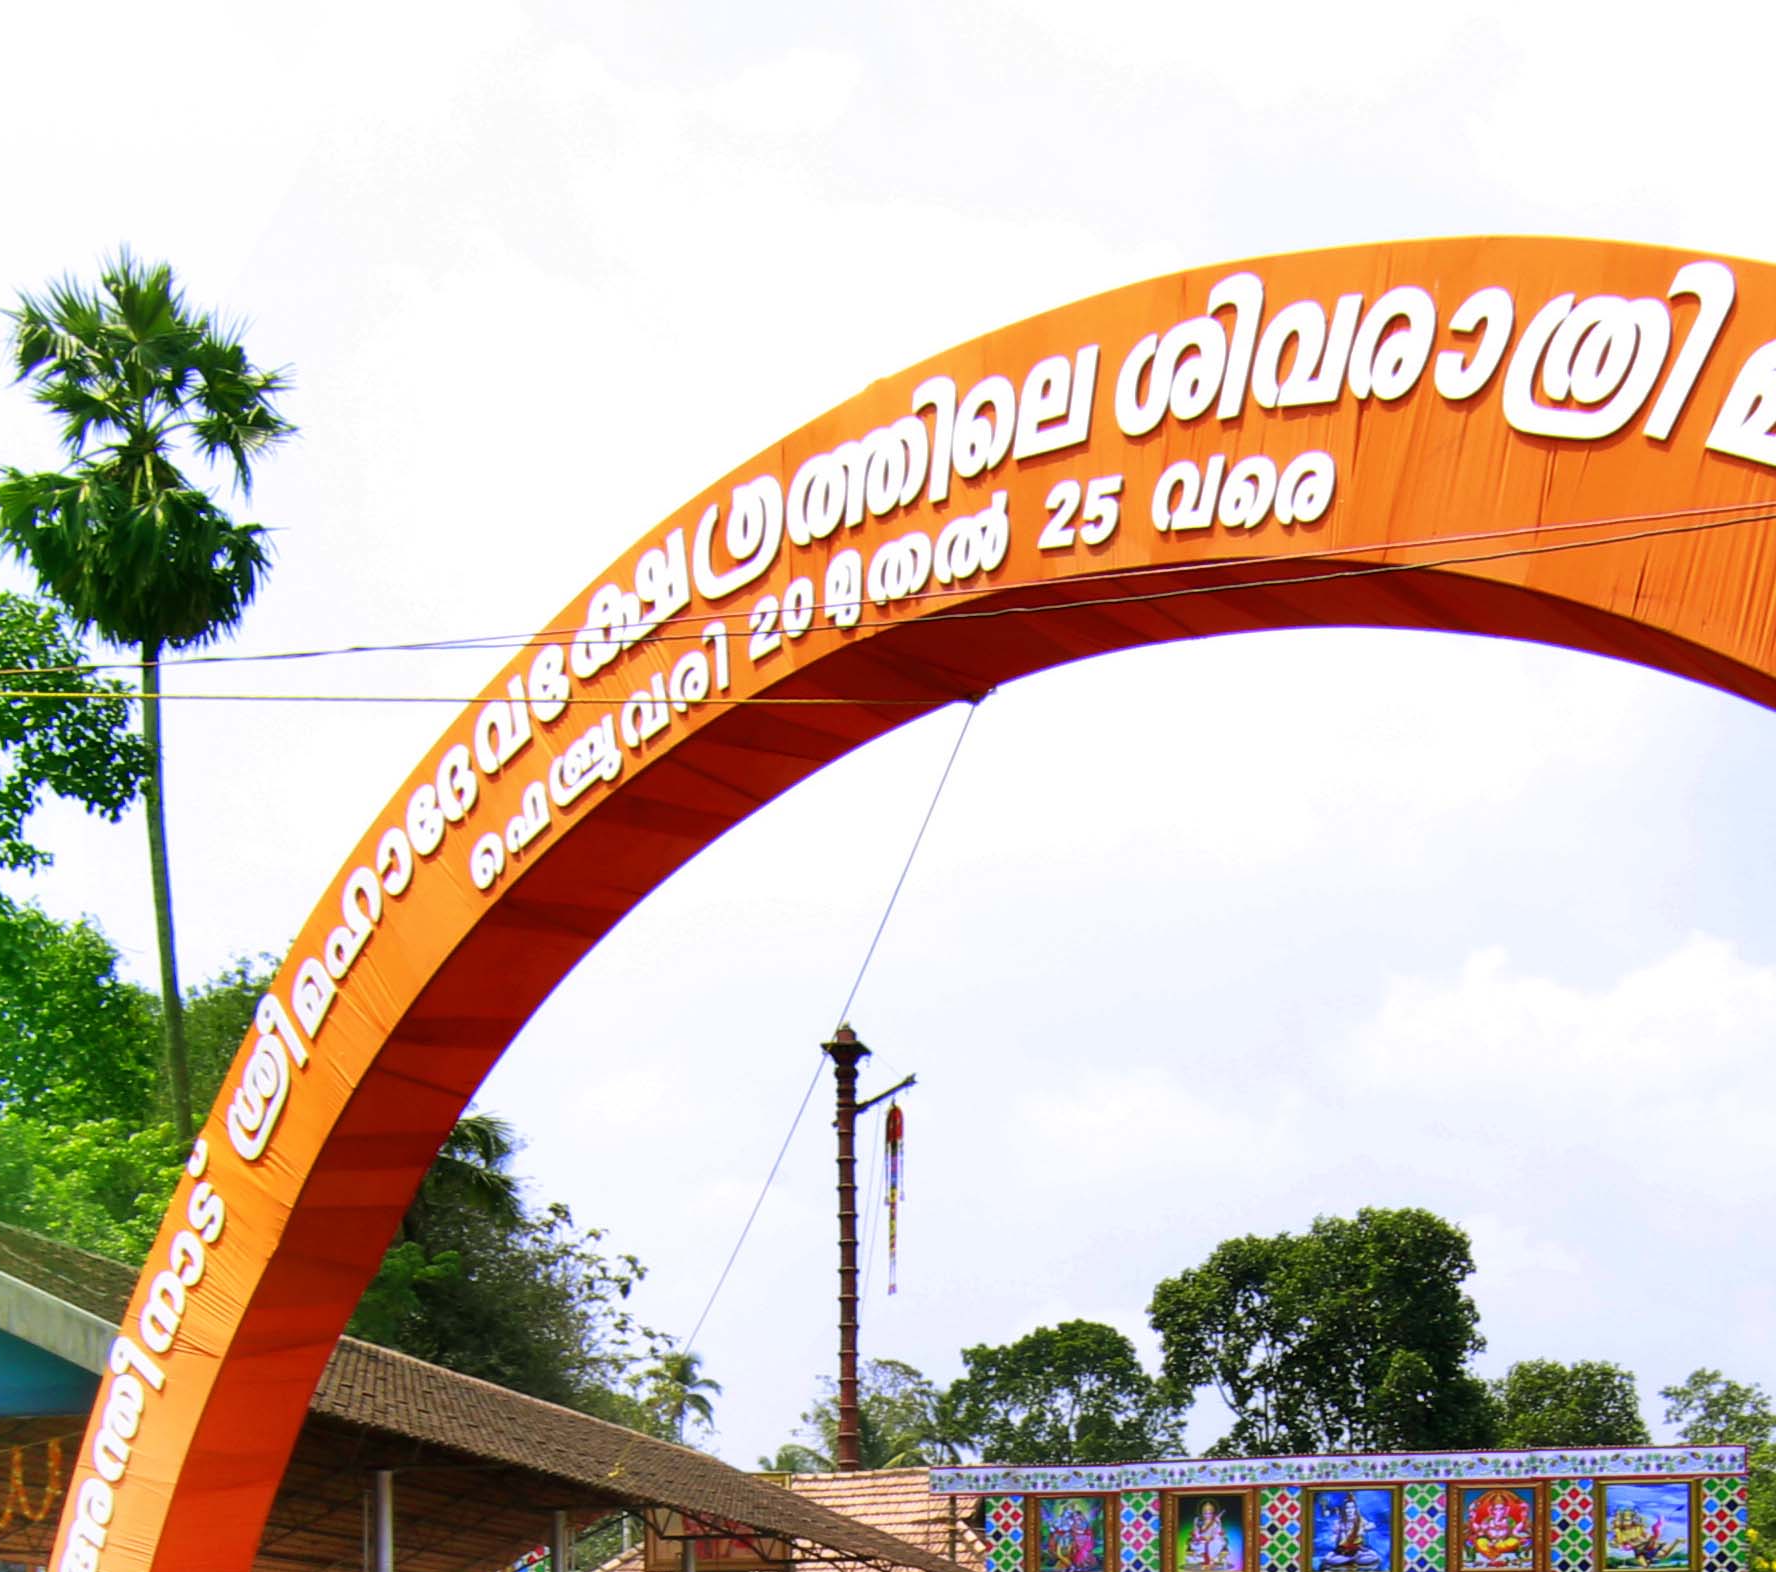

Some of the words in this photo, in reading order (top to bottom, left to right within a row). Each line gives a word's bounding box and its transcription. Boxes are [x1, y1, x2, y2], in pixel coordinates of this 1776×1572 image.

[1113, 261, 1736, 440] ശിവരാത്രി
[747, 592, 816, 662] 20
[1036, 473, 1124, 550] 25
[1150, 450, 1336, 531] വരെ
